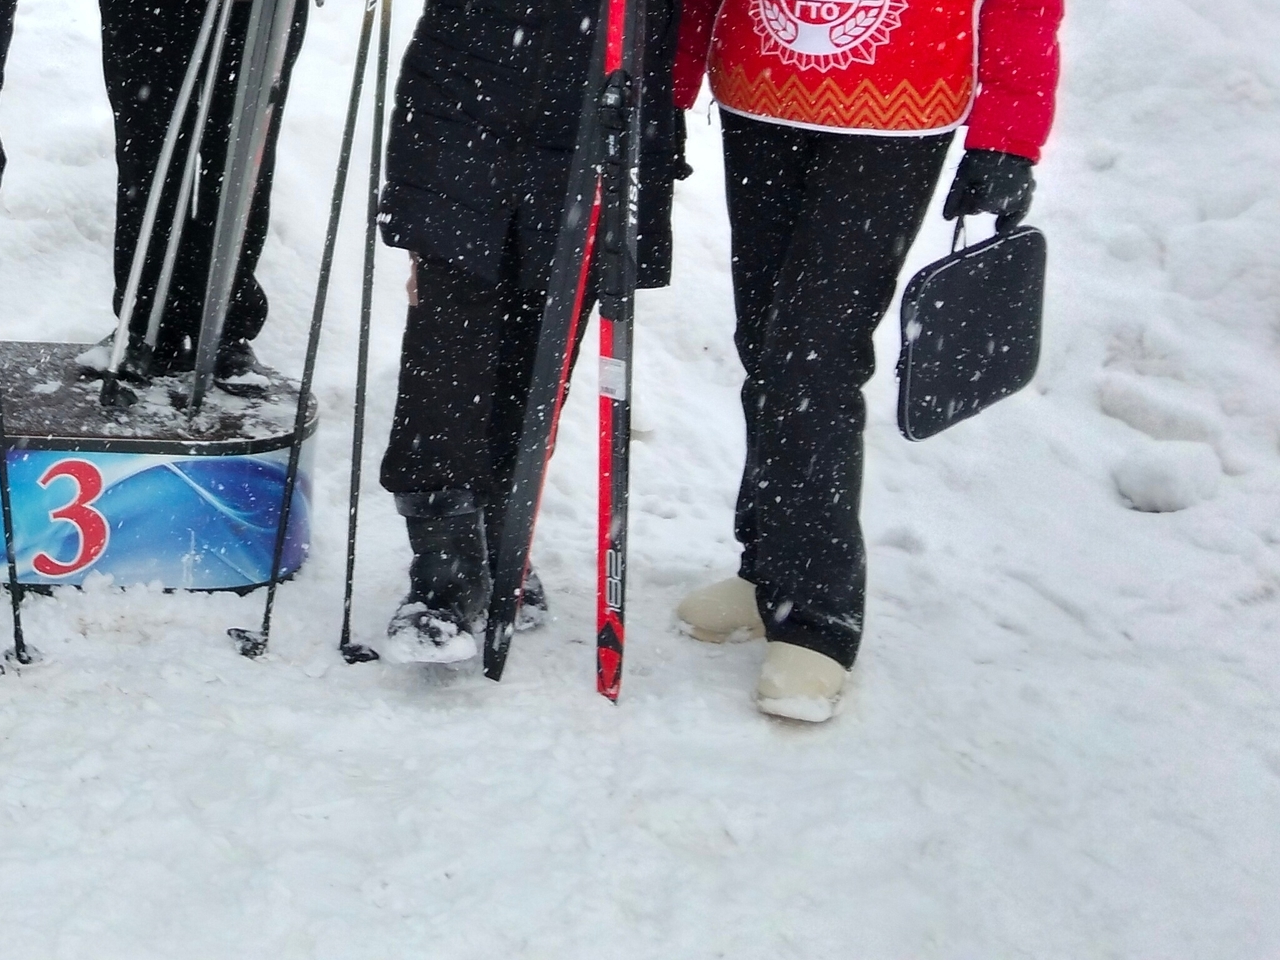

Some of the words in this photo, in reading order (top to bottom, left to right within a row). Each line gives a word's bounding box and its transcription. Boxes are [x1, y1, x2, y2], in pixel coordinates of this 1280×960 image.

[793, 0, 840, 20] ГТО
[31, 457, 111, 578] 3
[605, 549, 622, 615] 182
